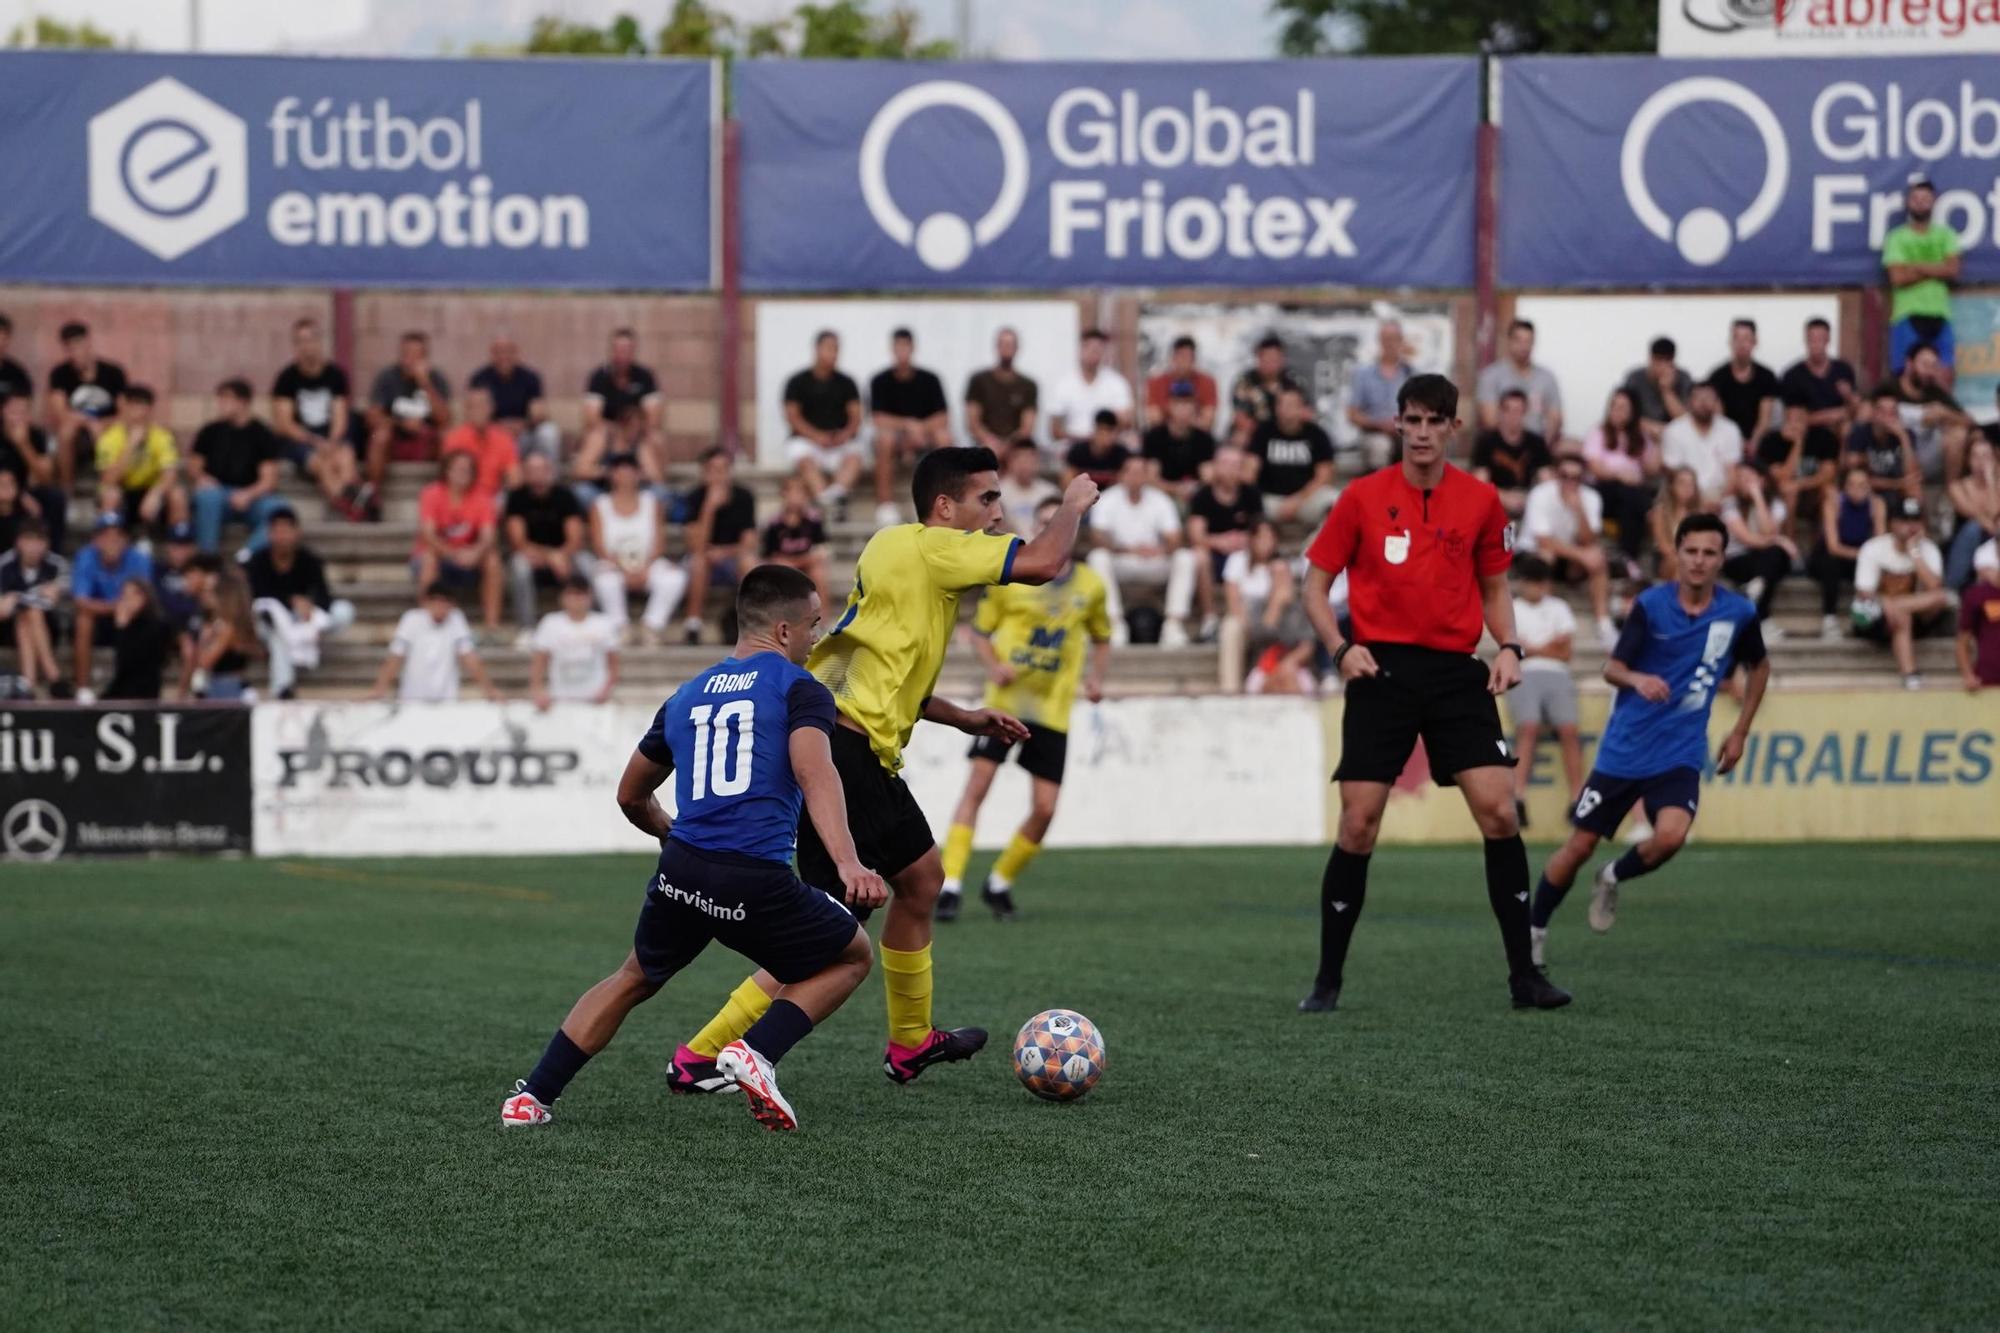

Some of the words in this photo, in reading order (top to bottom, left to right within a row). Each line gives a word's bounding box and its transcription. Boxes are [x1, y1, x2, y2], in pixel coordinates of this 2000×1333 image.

[267, 98, 482, 170] fútbol
[1047, 87, 1315, 168] Global
[1810, 80, 2000, 162] Glob
[266, 176, 589, 249] emotion
[1048, 182, 1358, 258] Friotex
[1811, 172, 2000, 254] Frot
[703, 671, 758, 693] FRANC
[95, 712, 225, 773] S.L.
[689, 699, 755, 801] 10
[657, 872, 746, 921] Servisimó
